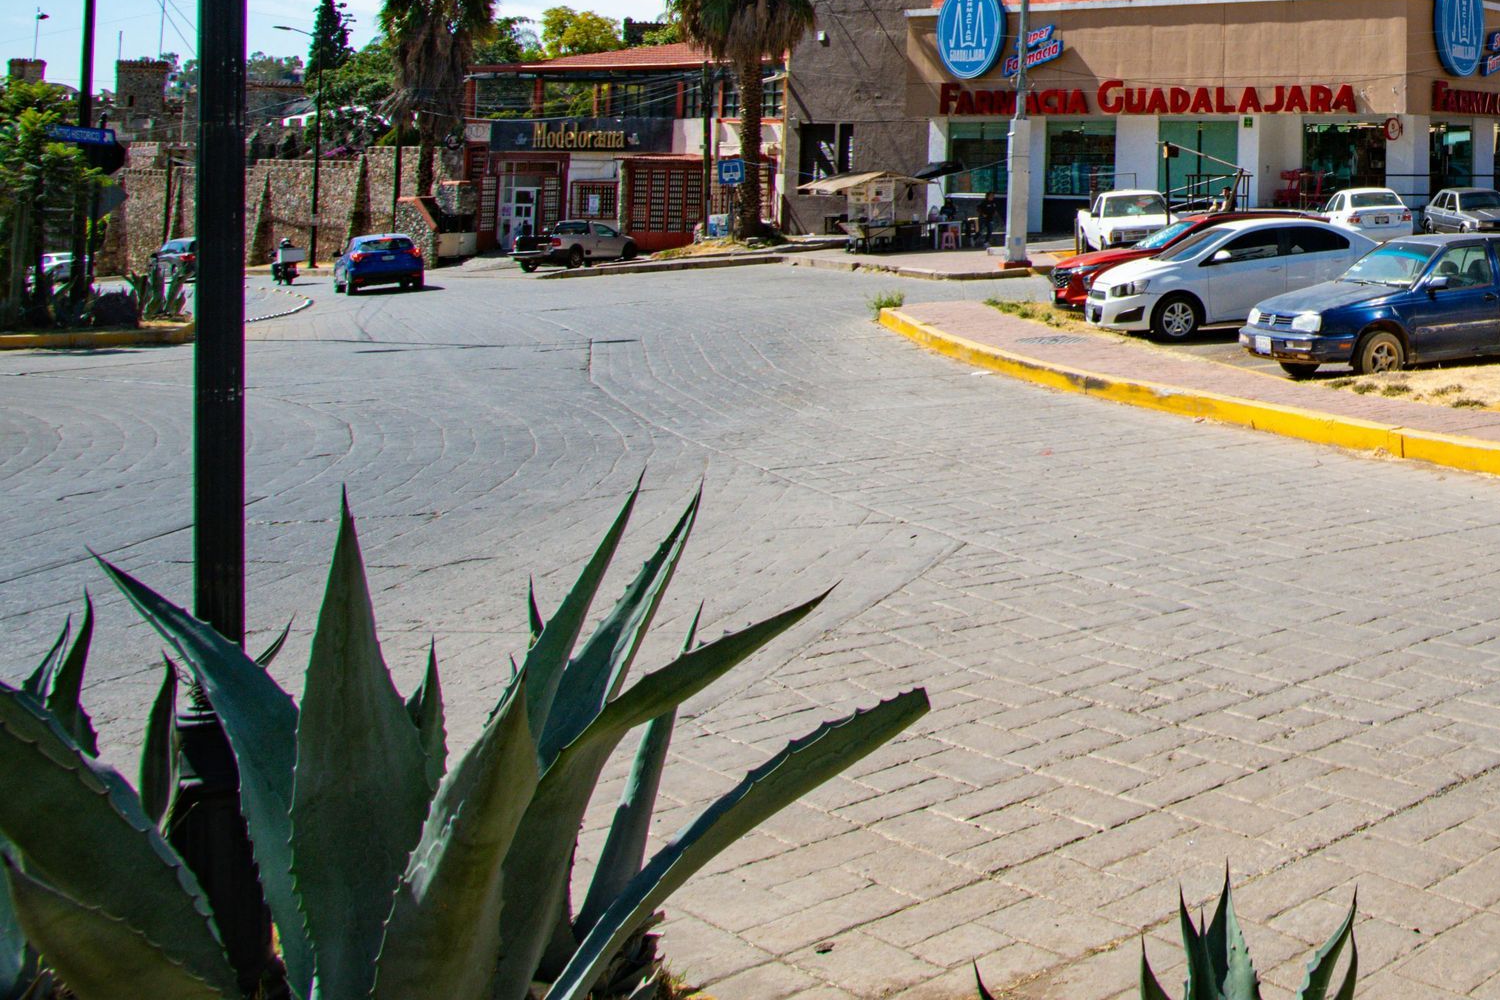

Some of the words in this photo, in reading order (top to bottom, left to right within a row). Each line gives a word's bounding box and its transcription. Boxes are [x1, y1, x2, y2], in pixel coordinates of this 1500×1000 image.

[1005, 43, 1059, 73] Famacia
[1097, 80, 1357, 114] GUADALAJARA
[532, 121, 625, 149] Modelorama
